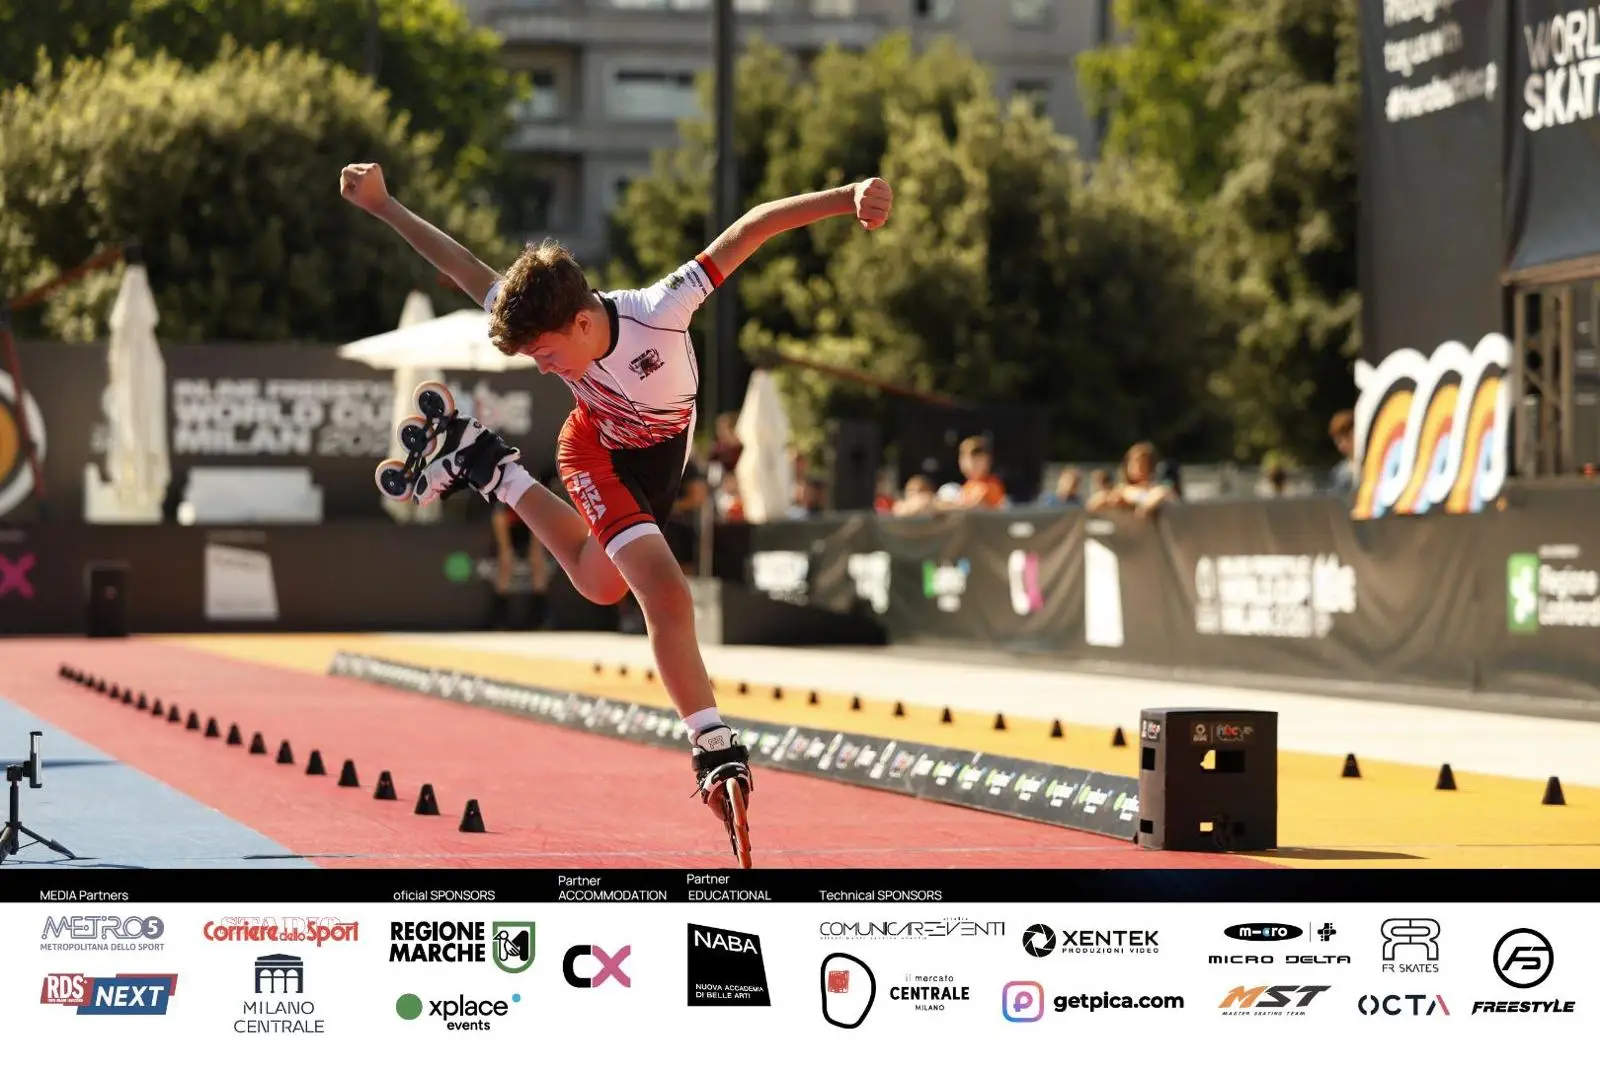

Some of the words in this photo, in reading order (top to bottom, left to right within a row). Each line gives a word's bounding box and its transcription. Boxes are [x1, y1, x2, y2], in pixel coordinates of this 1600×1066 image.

[1524, 4, 1600, 70] WORL
[1523, 56, 1600, 131] SKAT
[175, 399, 324, 429] WORLD
[330, 400, 394, 429] CU
[174, 426, 313, 454] MILAN
